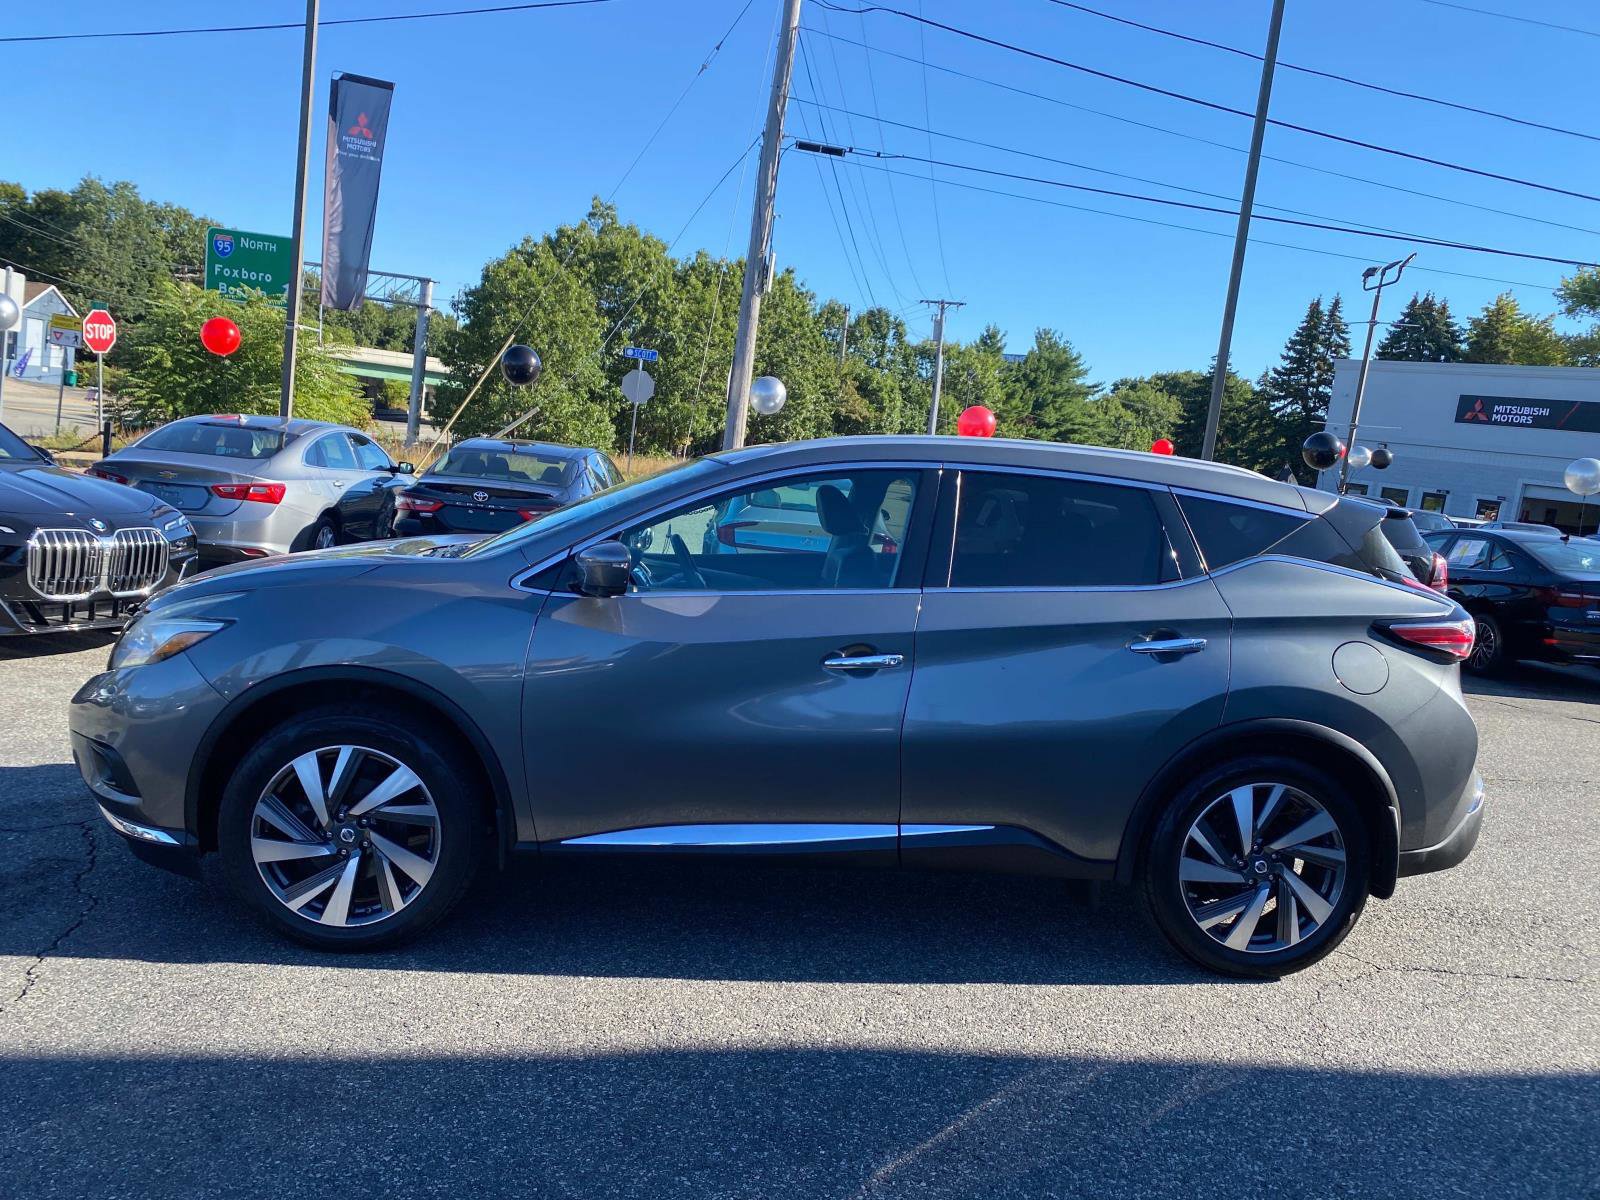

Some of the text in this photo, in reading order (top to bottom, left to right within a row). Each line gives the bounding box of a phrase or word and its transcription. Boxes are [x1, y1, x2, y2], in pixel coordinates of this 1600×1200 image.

[342, 135, 377, 148] MITSUBISHI
[346, 143, 371, 153] MOTORS
[217, 240, 231, 253] 95
[214, 264, 273, 282] Foxboro
[86, 323, 114, 340] STOP
[634, 349, 652, 360] SCOTT
[1493, 405, 1550, 416] MITSUBISHI
[1491, 414, 1534, 424] MOTORS
